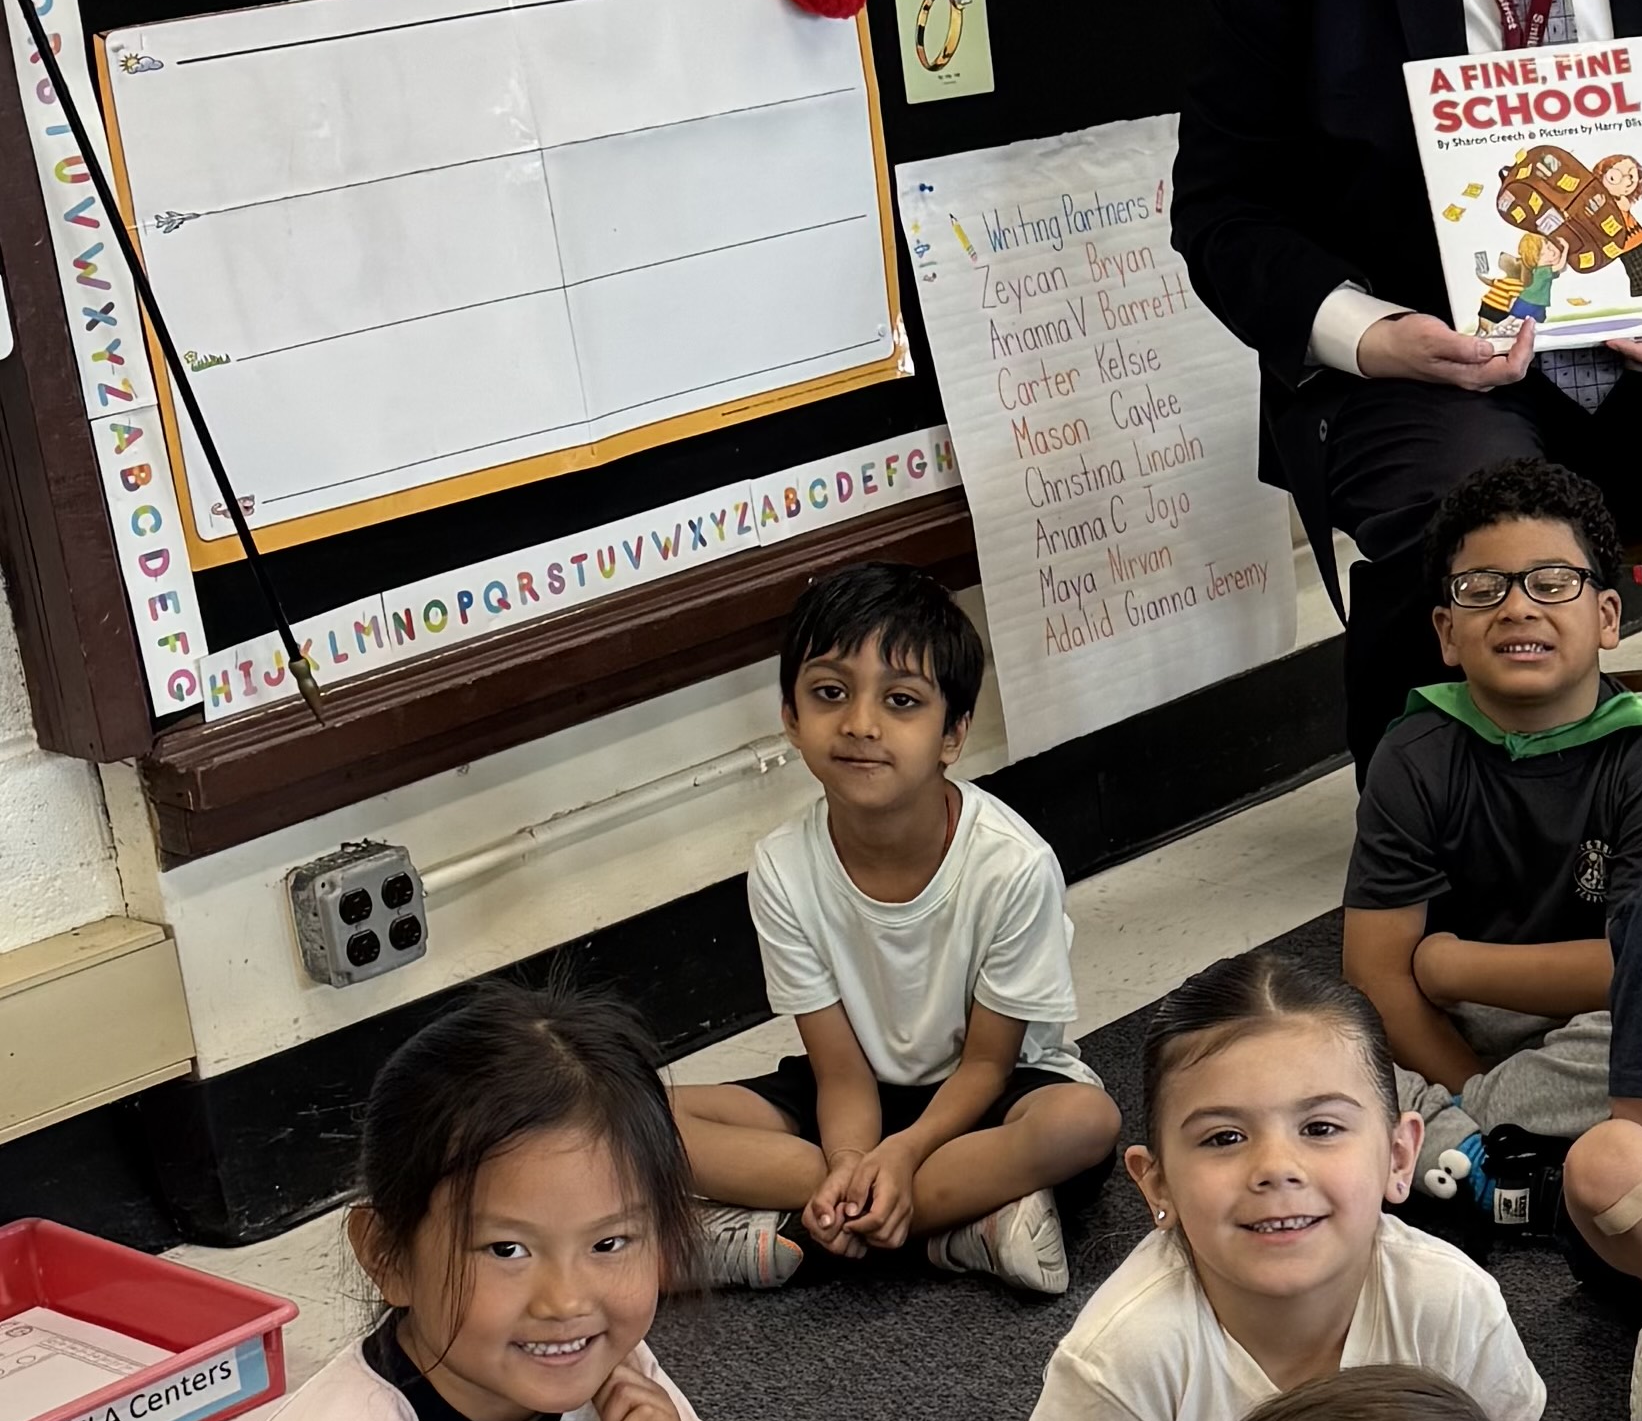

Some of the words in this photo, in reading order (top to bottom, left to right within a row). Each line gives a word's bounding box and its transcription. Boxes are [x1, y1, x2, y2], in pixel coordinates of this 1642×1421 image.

[1429, 68, 1456, 94] A
[1459, 58, 1548, 90] FINE,
[1554, 48, 1632, 80] FINE
[1433, 82, 1641, 133] SCHOOL
[1437, 139, 1449, 150] By
[1452, 135, 1487, 148] Sharon
[1489, 131, 1524, 144] Creech
[1539, 124, 1578, 138] Pictures
[1581, 123, 1592, 135] by
[1594, 119, 1623, 132] Harry
[982, 208, 1062, 254] Writing
[1062, 190, 1149, 238] Partners
[976, 264, 1068, 314] Zeycan
[1086, 242, 1155, 288] Bryan
[989, 309, 1071, 360] Arianna
[1066, 295, 1087, 335] V
[1099, 272, 1189, 334] Barrett
[998, 358, 1080, 412] Carter
[1095, 342, 1161, 383] Kelsie
[1012, 414, 1091, 459] Mason
[1110, 384, 1181, 436] Caylee
[1025, 452, 1124, 508] Christina
[1133, 426, 1204, 478] Lincoln
[1036, 514, 1108, 559] Ariana
[1109, 494, 1127, 535] C
[1144, 489, 1191, 533] Jojo
[1040, 566, 1096, 609] Maya
[1108, 544, 1172, 587] Nirvan
[1045, 608, 1114, 658] Adalid
[1125, 583, 1196, 626] Gianna
[1206, 558, 1268, 602] Jeremy
[129, 1360, 231, 1419] Centers
